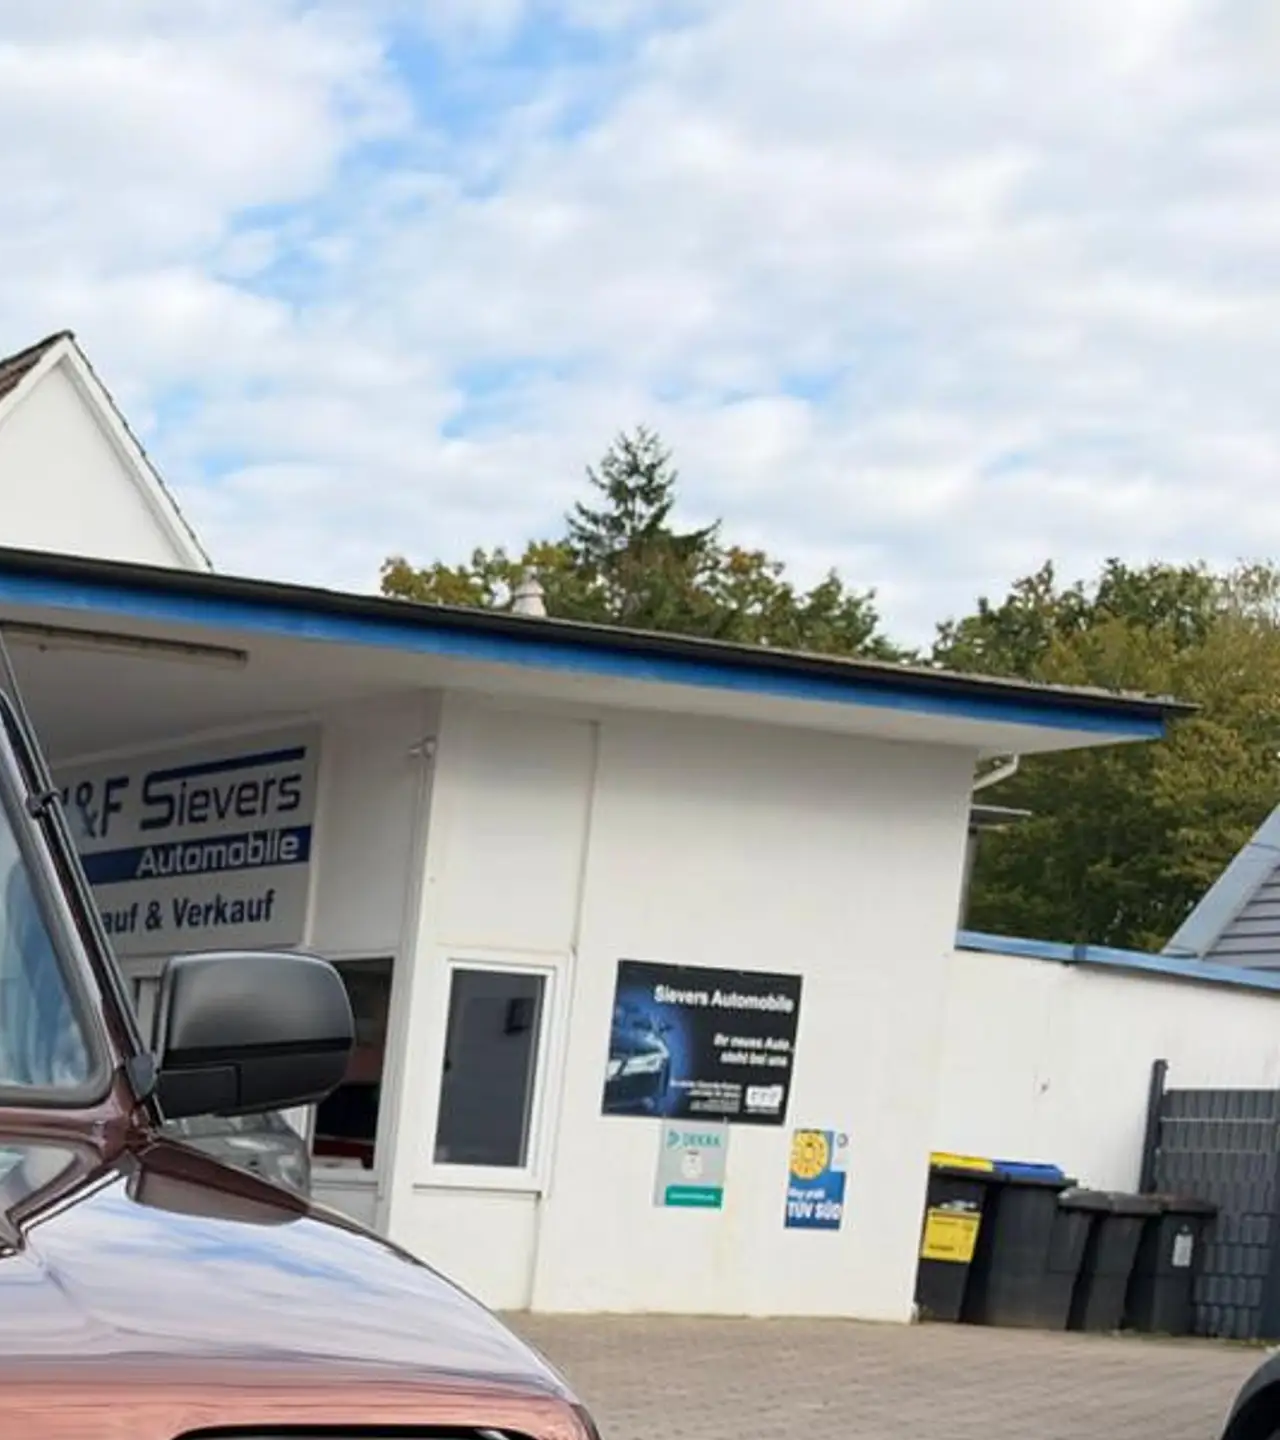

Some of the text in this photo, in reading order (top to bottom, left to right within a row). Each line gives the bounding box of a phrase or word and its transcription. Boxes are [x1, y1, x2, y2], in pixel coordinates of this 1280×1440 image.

[61, 746, 307, 839] &F Sievers
[136, 830, 300, 876] Automobile
[102, 888, 275, 935] auf & Verkauf
[654, 984, 794, 1014] Sievers Automobile
